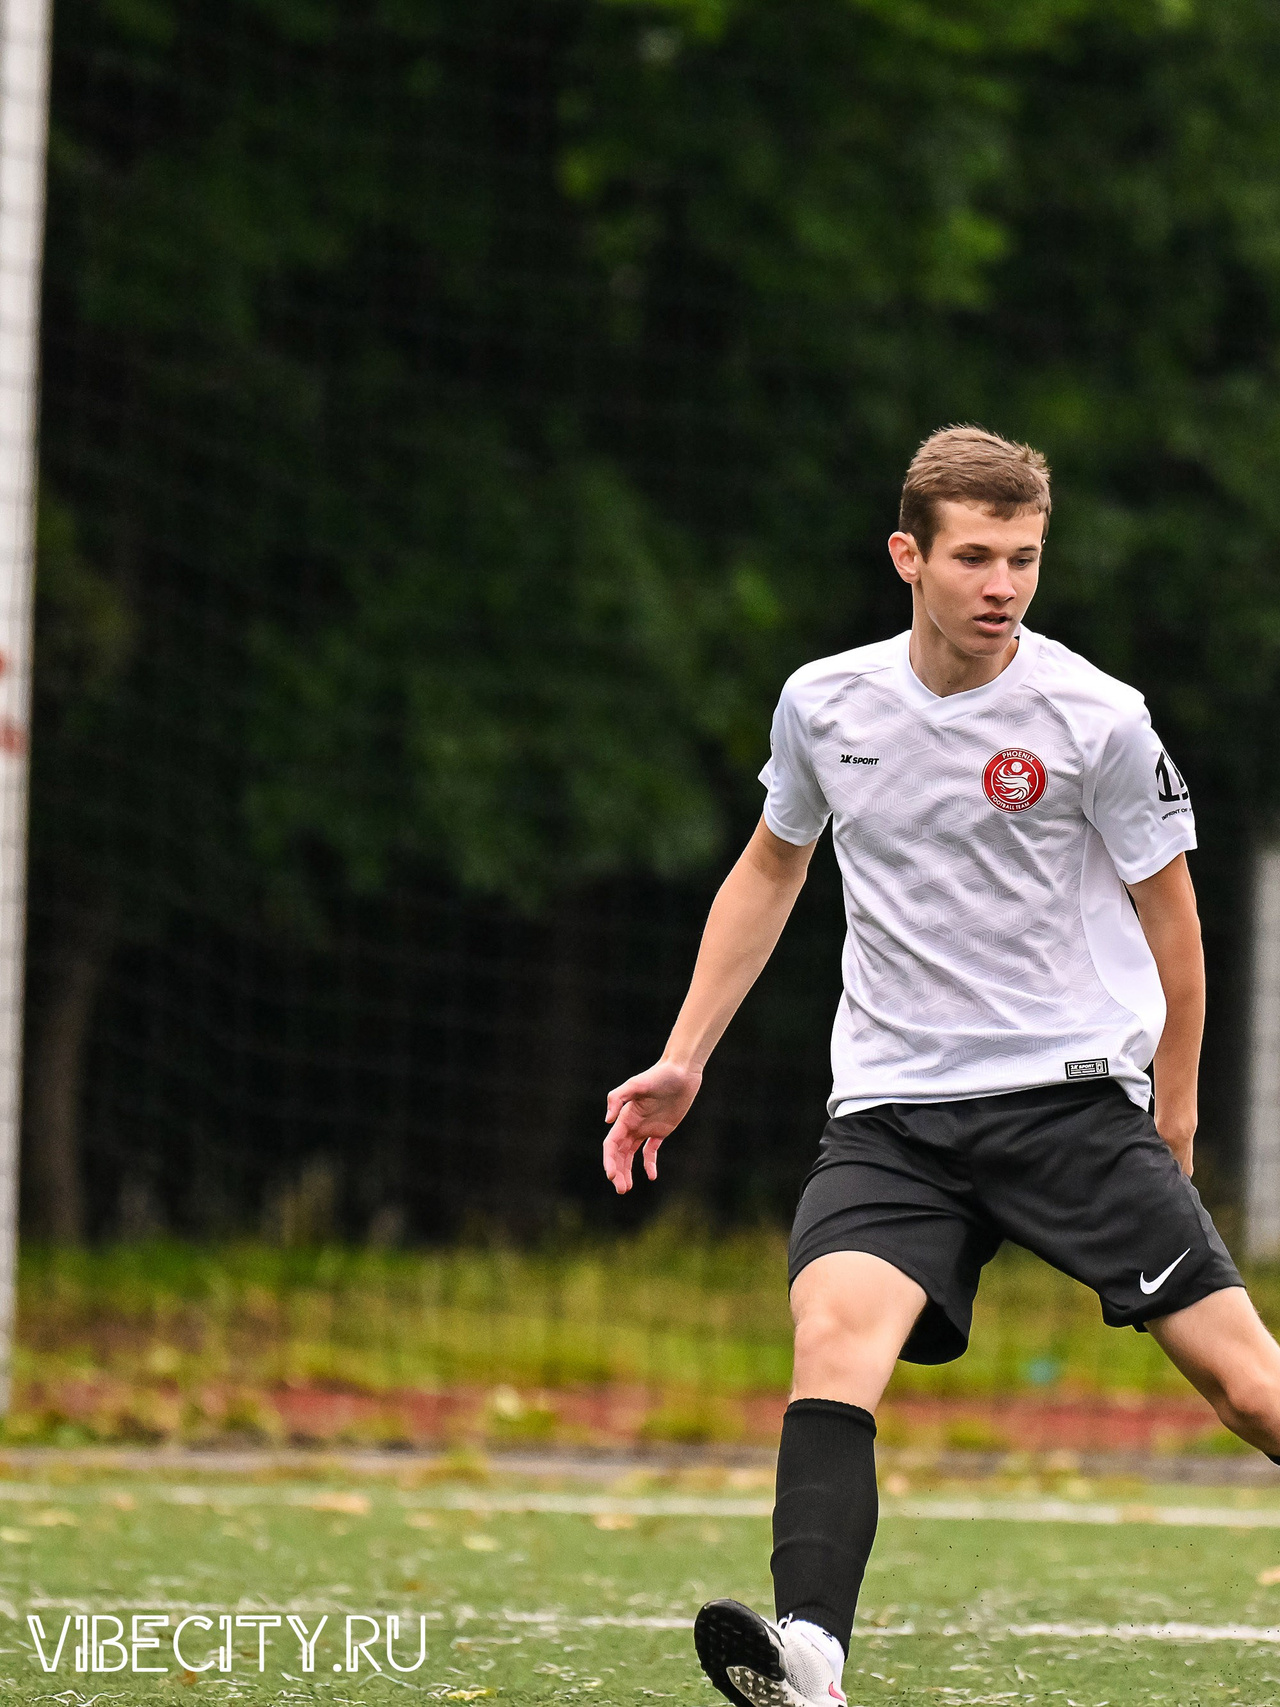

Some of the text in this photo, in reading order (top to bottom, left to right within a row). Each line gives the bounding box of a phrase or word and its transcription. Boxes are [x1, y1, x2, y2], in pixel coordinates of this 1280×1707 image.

[852, 757, 880, 765] SPORT
[1002, 750, 1035, 763] PHOENIX
[990, 794, 1030, 810] FOOTBALL TEAM
